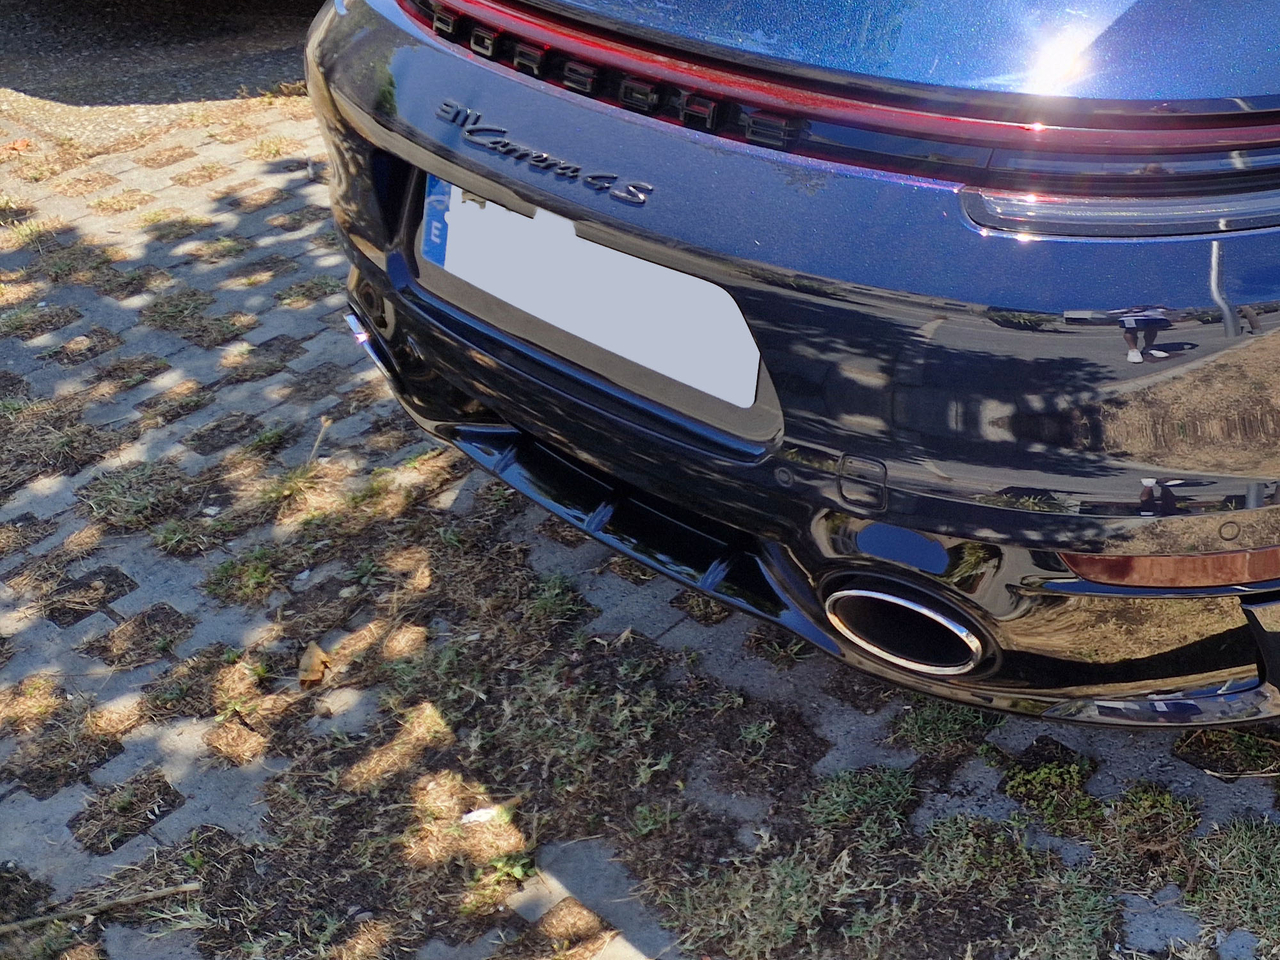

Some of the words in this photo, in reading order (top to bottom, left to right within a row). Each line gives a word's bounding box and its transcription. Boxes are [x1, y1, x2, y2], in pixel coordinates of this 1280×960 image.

[432, 8, 792, 147] PORSCHE
[435, 98, 482, 127] 911
[462, 123, 583, 180] Carrera
[430, 220, 443, 245] E
